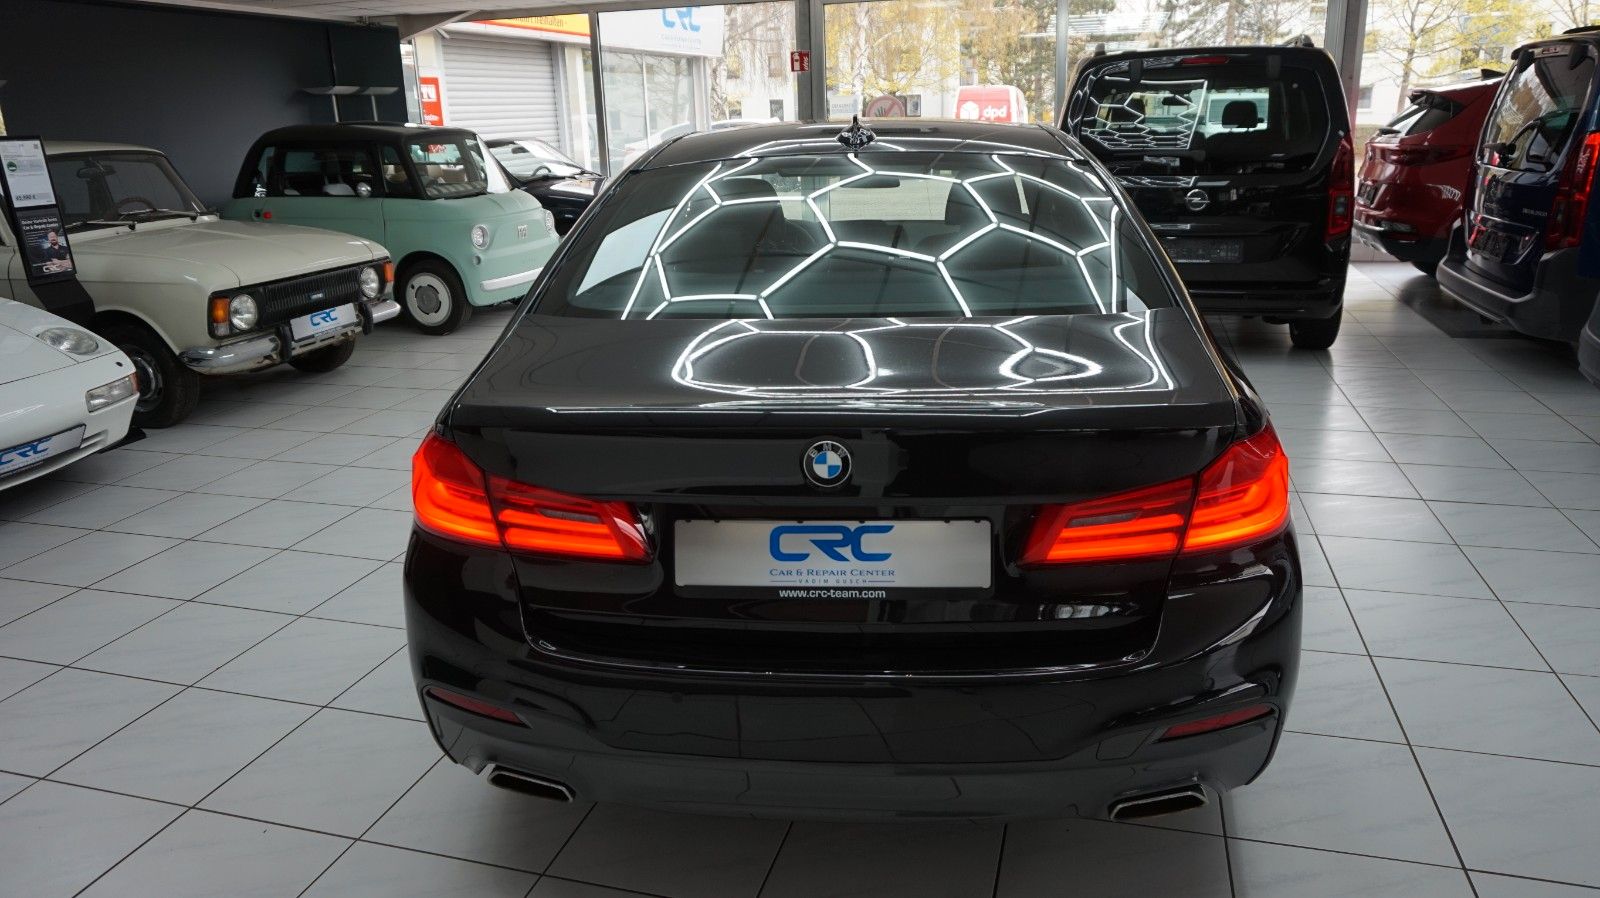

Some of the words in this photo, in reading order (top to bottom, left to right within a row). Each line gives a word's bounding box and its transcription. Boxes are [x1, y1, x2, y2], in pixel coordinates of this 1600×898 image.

[983, 105, 1007, 121] dpd
[309, 307, 338, 327] CRC
[808, 442, 848, 458] BMW
[769, 525, 895, 562] CRC
[769, 568, 793, 577] CAR
[806, 568, 847, 577] REPAIR
[850, 568, 896, 577] CENTER
[779, 588, 886, 599] www.crc-team.com
